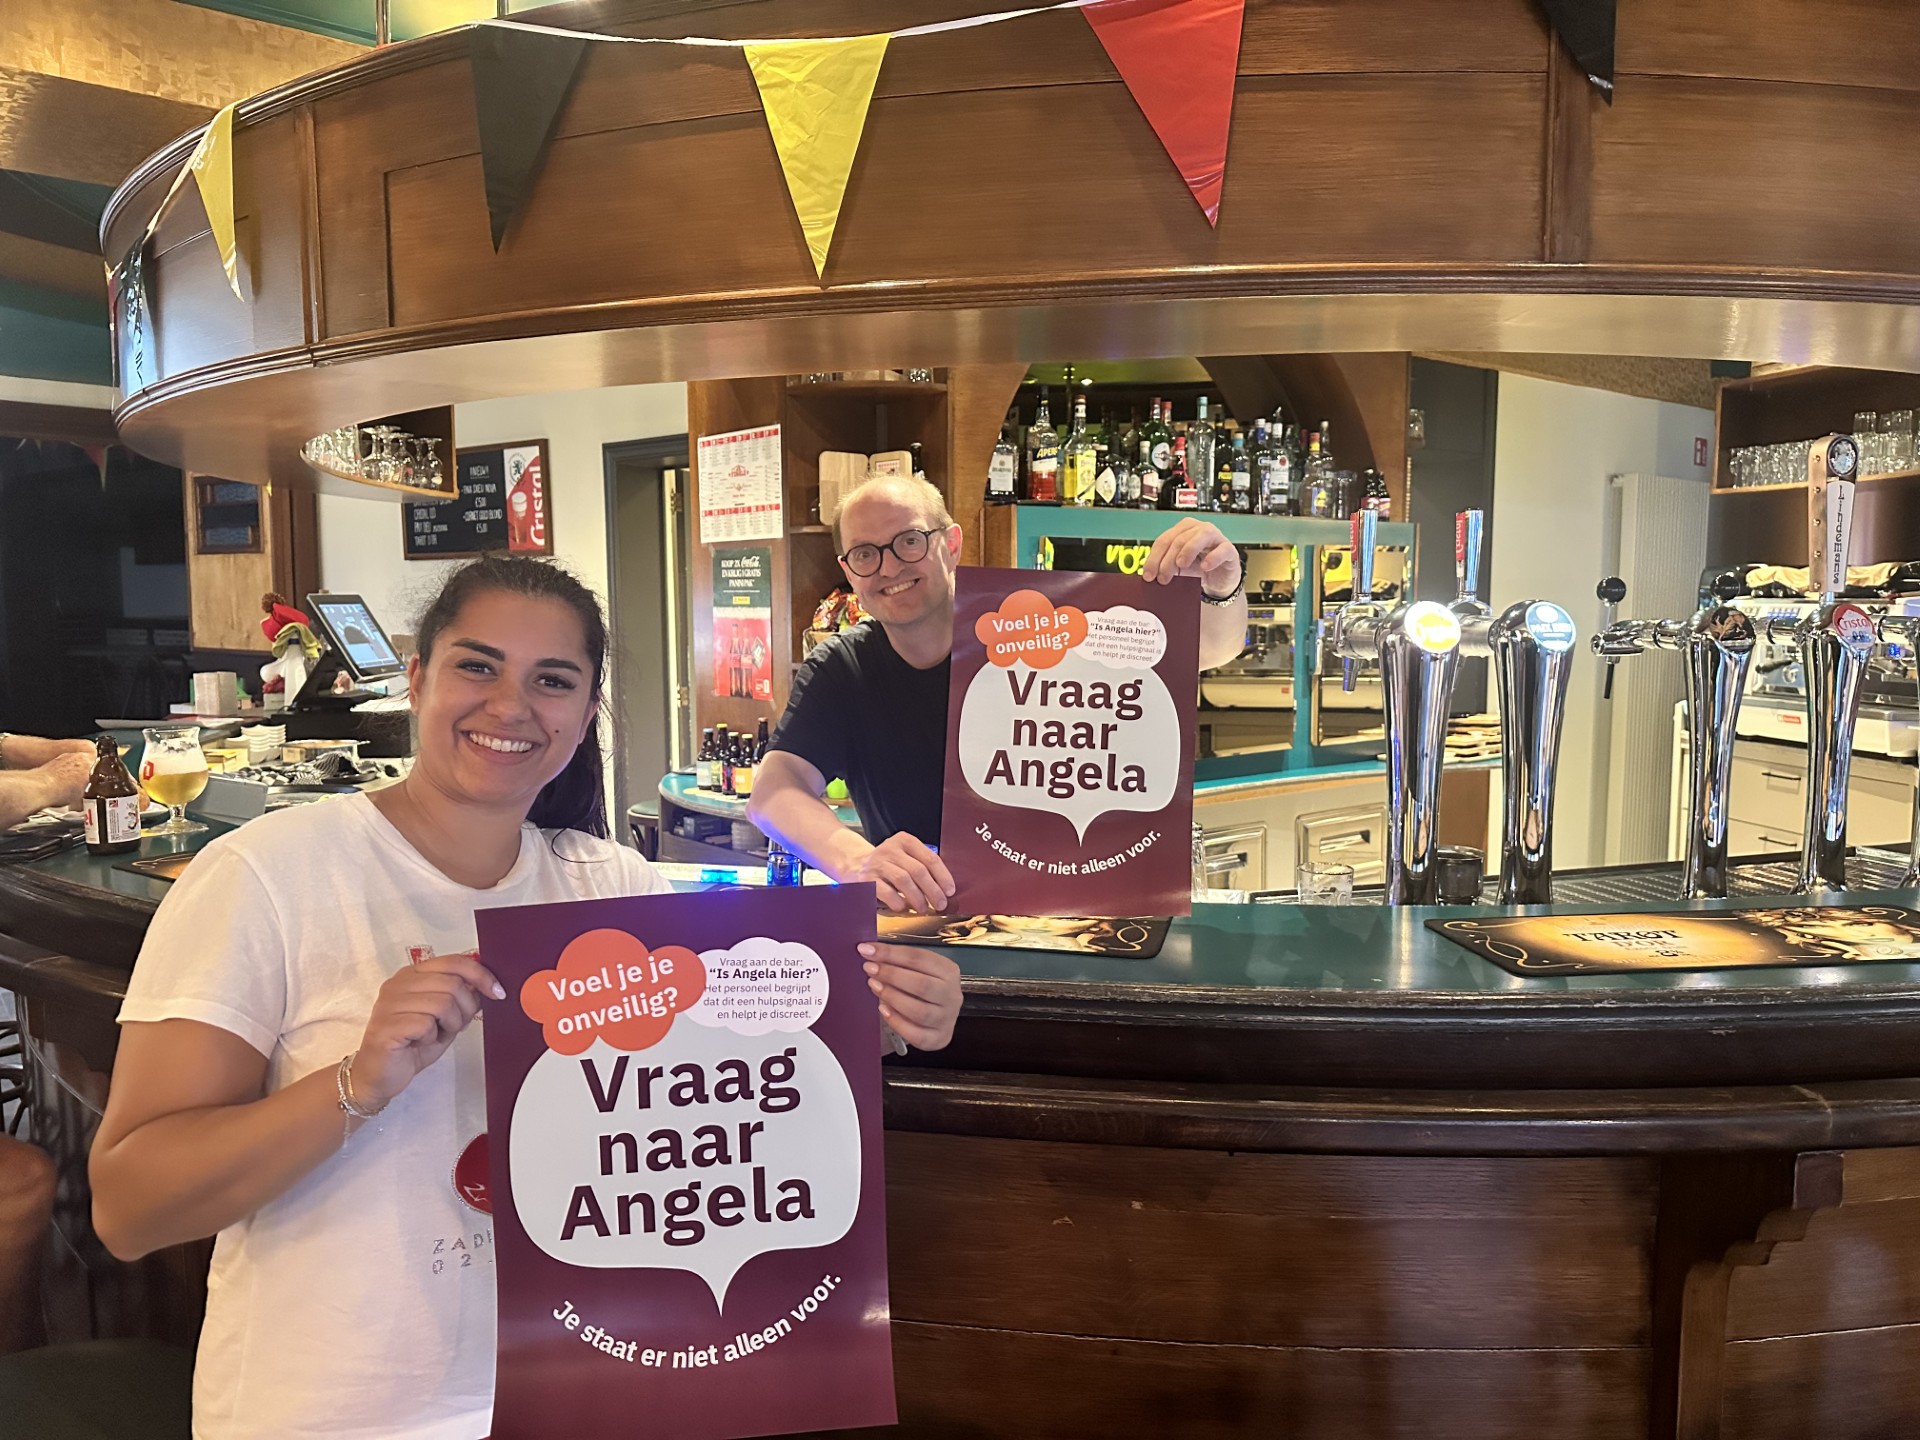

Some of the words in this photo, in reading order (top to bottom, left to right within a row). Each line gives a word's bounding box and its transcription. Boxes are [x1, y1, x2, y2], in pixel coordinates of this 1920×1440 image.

[529, 465, 545, 546] Cristal
[1833, 484, 1846, 584] Lindemans
[992, 613, 1031, 633] Voel
[1033, 613, 1049, 632] je
[1052, 610, 1069, 630] je
[1097, 617, 1115, 625] Vraag
[1104, 624, 1133, 634] Angela
[995, 631, 1071, 655] onveilig?
[1098, 634, 1130, 642] personeel
[1130, 637, 1155, 646] begrijpt
[1119, 644, 1155, 654] hulpsignaal
[1006, 670, 1144, 721] Vraag
[1012, 718, 1118, 750] naar
[983, 749, 1148, 799] Angela
[974, 821, 993, 842] Je
[991, 837, 1027, 866] staat
[1028, 856, 1045, 873] er
[1048, 860, 1078, 876] niet
[1081, 852, 1127, 875] alleen
[1125, 829, 1163, 859] voor.
[1562, 929, 1683, 942] TAROT
[720, 957, 748, 968] Vraag
[749, 959, 768, 967] aan
[769, 957, 782, 967] de
[784, 957, 803, 967] bar:
[732, 968, 777, 982] Angela
[547, 966, 612, 1001] Voel
[616, 963, 643, 991] je
[647, 955, 674, 984] je
[704, 983, 721, 993] Het
[723, 983, 772, 994] personeel
[774, 983, 811, 995] begrijpt
[557, 986, 678, 1035] onveilig?
[703, 997, 719, 1006] dat
[722, 996, 735, 1006] dit
[737, 998, 755, 1006] een
[757, 996, 812, 1008] hulpsignaal
[814, 997, 823, 1006] is
[717, 1011, 729, 1019] en
[731, 1010, 757, 1020] helpt
[759, 1010, 768, 1021] je
[769, 1009, 811, 1019] discreet.
[580, 1046, 801, 1114] Vraag
[599, 1120, 765, 1176] naar
[559, 1166, 816, 1247] Angela
[552, 1300, 581, 1331] Je
[580, 1323, 639, 1364] staat
[640, 1347, 667, 1368] er
[671, 1344, 719, 1370] niet
[723, 1316, 793, 1363] alleen
[789, 1273, 843, 1324] voor.
